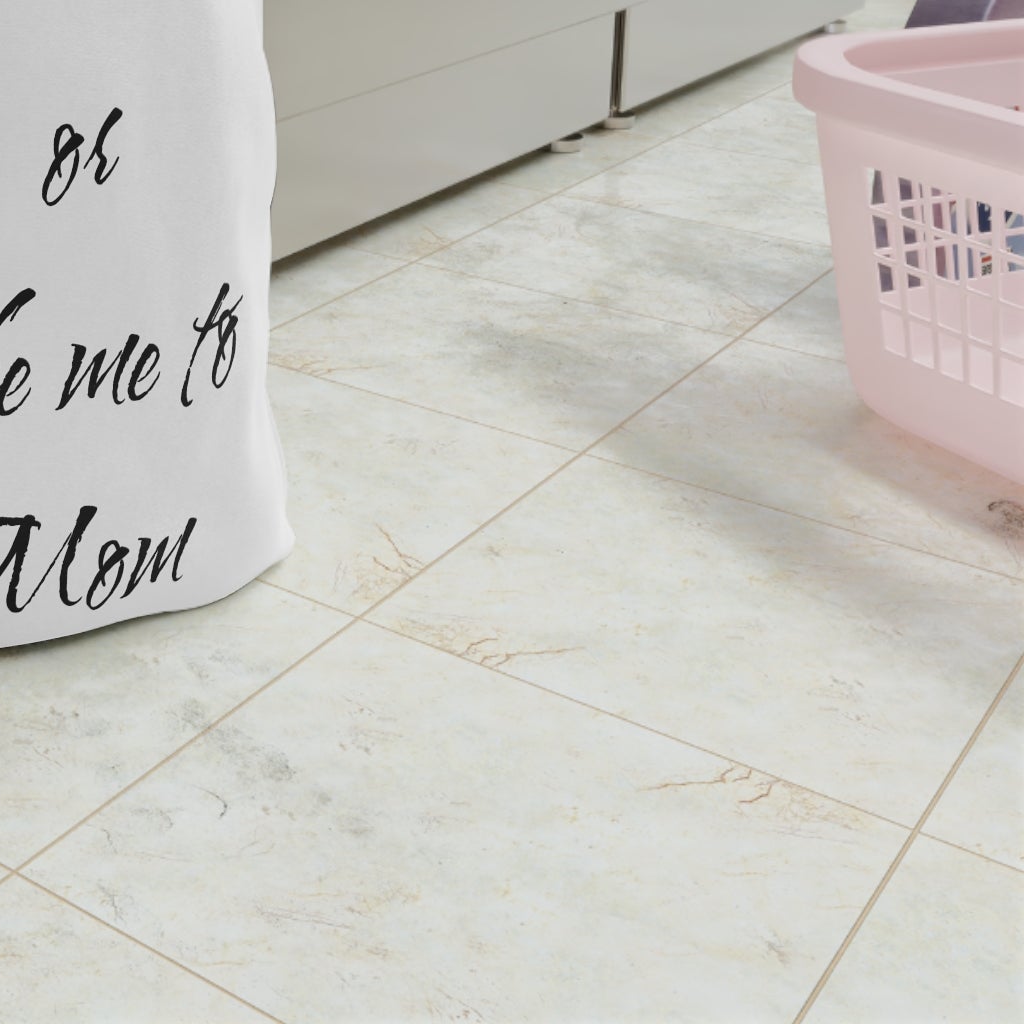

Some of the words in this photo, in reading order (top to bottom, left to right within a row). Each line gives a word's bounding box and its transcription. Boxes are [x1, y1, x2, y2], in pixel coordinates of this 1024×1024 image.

[42, 107, 123, 206] or
[55, 334, 161, 411] me
[181, 282, 243, 407] to
